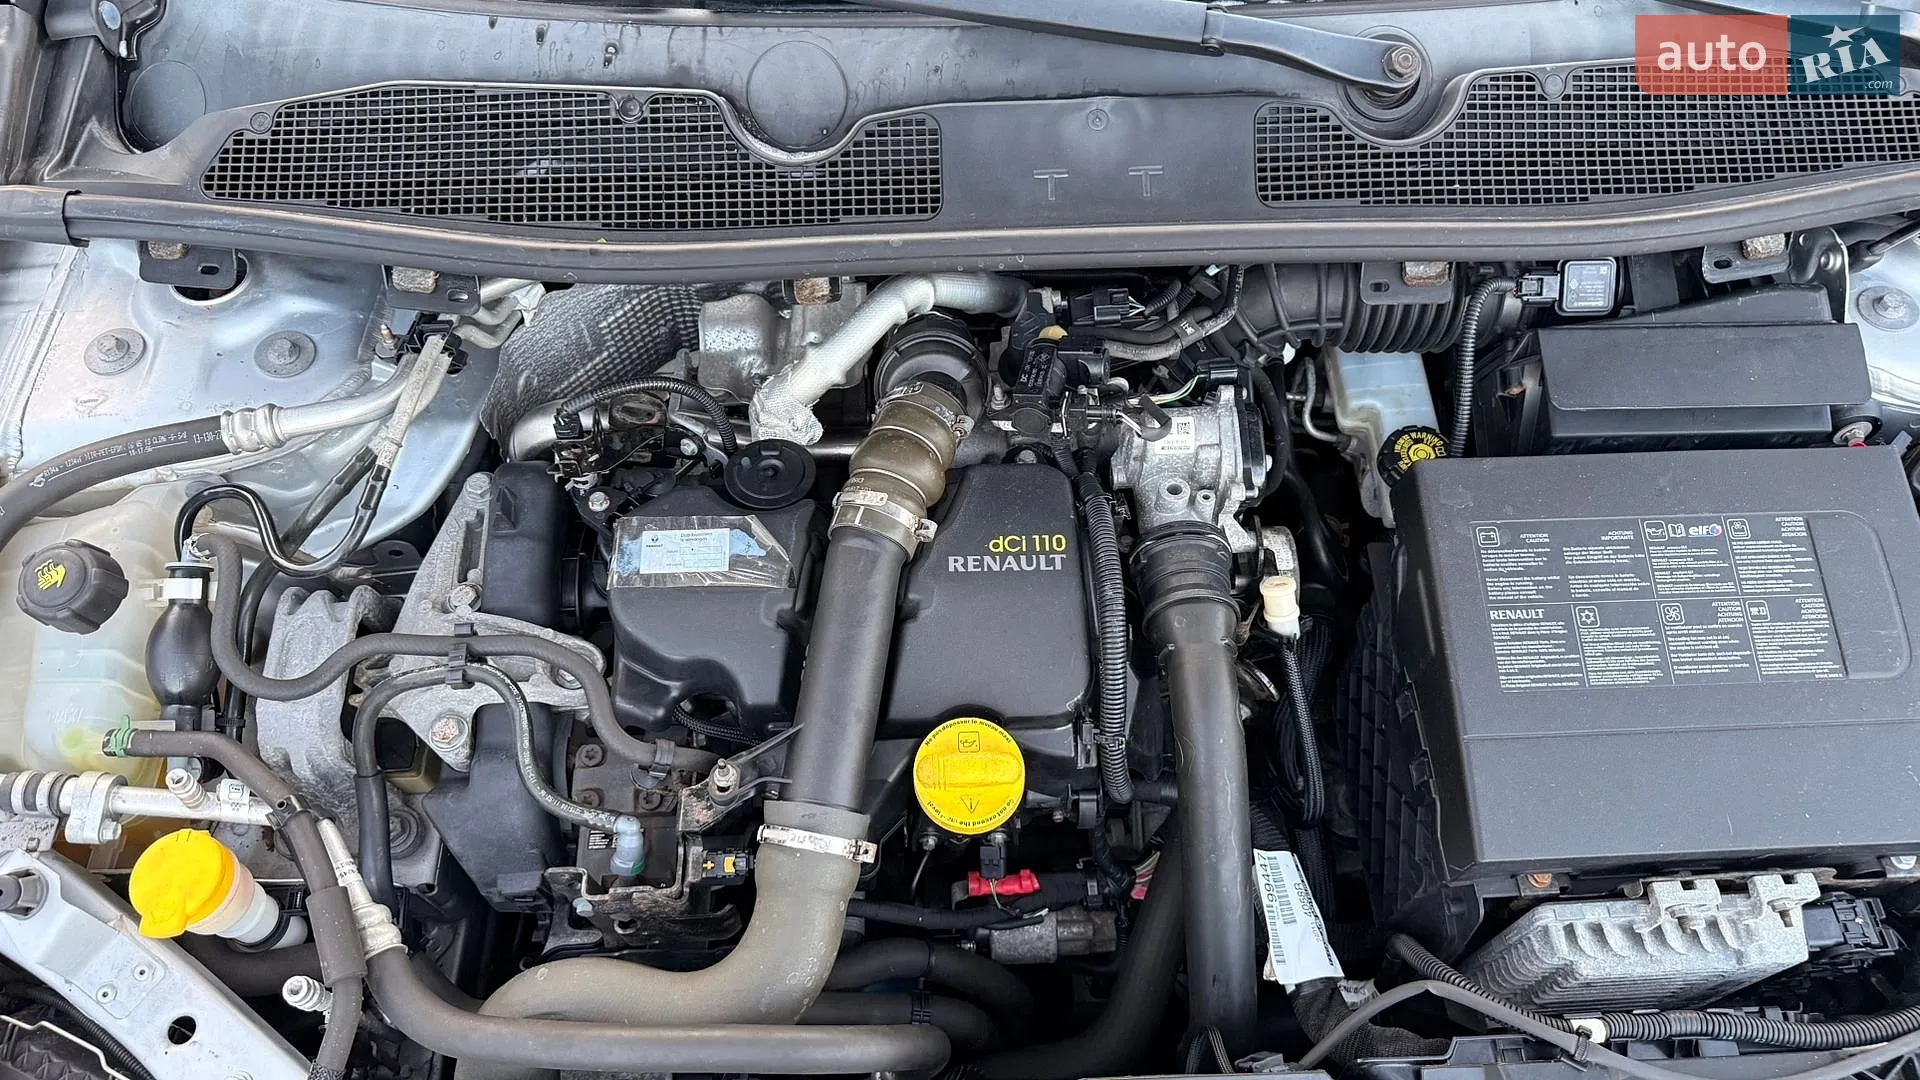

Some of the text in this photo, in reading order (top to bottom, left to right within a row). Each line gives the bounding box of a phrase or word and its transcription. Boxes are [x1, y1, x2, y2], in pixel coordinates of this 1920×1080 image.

[989, 534, 1067, 552] dCi 110
[948, 554, 1066, 572] RENAULT
[1489, 609, 1544, 620] RENAULT
[1257, 853, 1277, 902] 99447
